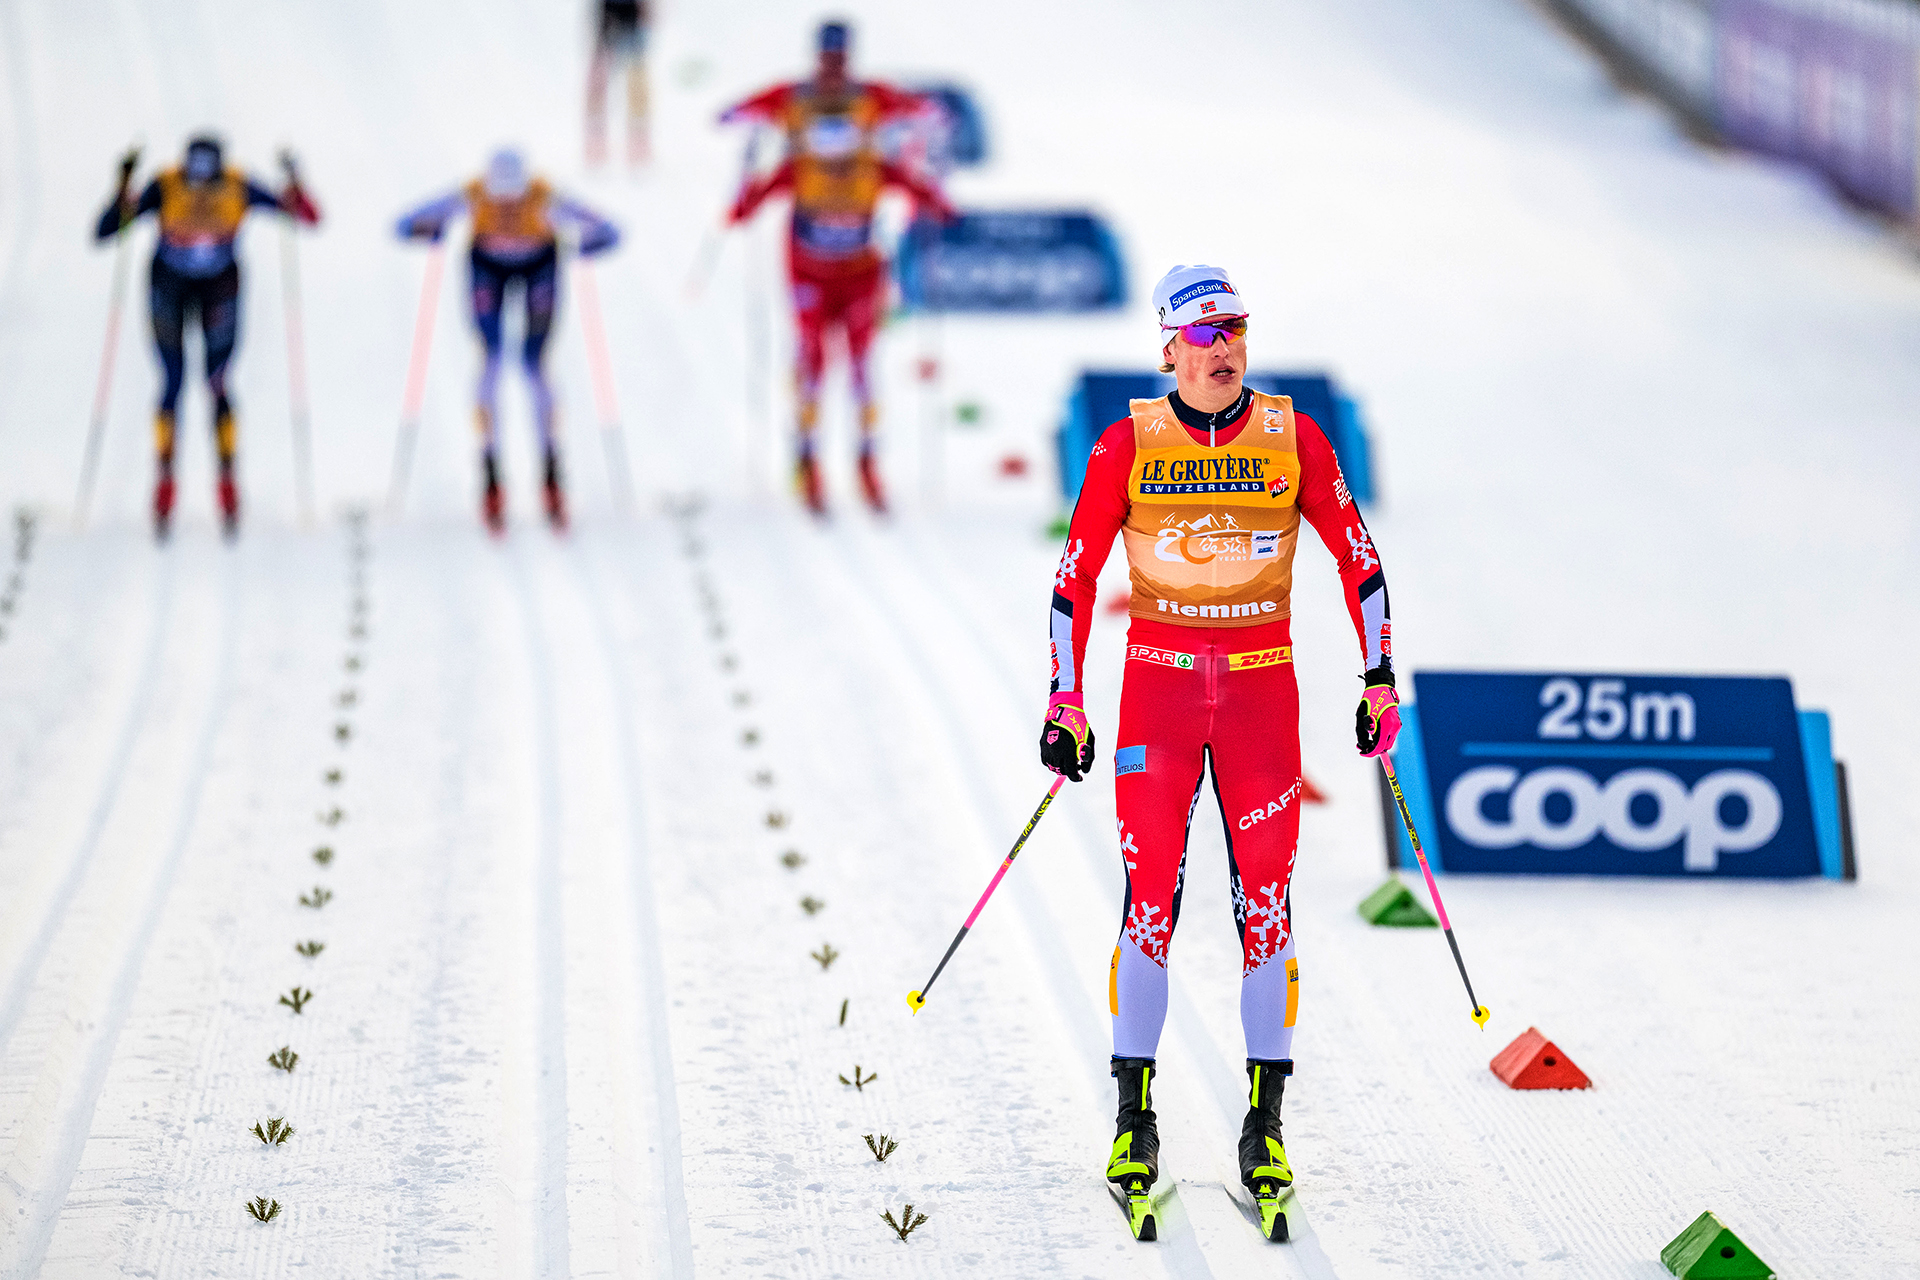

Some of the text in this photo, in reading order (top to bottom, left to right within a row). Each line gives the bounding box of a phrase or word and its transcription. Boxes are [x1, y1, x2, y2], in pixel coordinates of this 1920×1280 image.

[1171, 283, 1223, 308] SpareBank
[1141, 460, 1165, 481] LE
[1144, 483, 1260, 493] SWITZERLAND
[1130, 648, 1174, 663] SPAR
[1240, 650, 1287, 667] DHL
[1372, 690, 1388, 716] LEKI
[1537, 677, 1697, 742] 25m
[1239, 783, 1296, 831] CRAFT
[1444, 764, 1784, 872] coop
